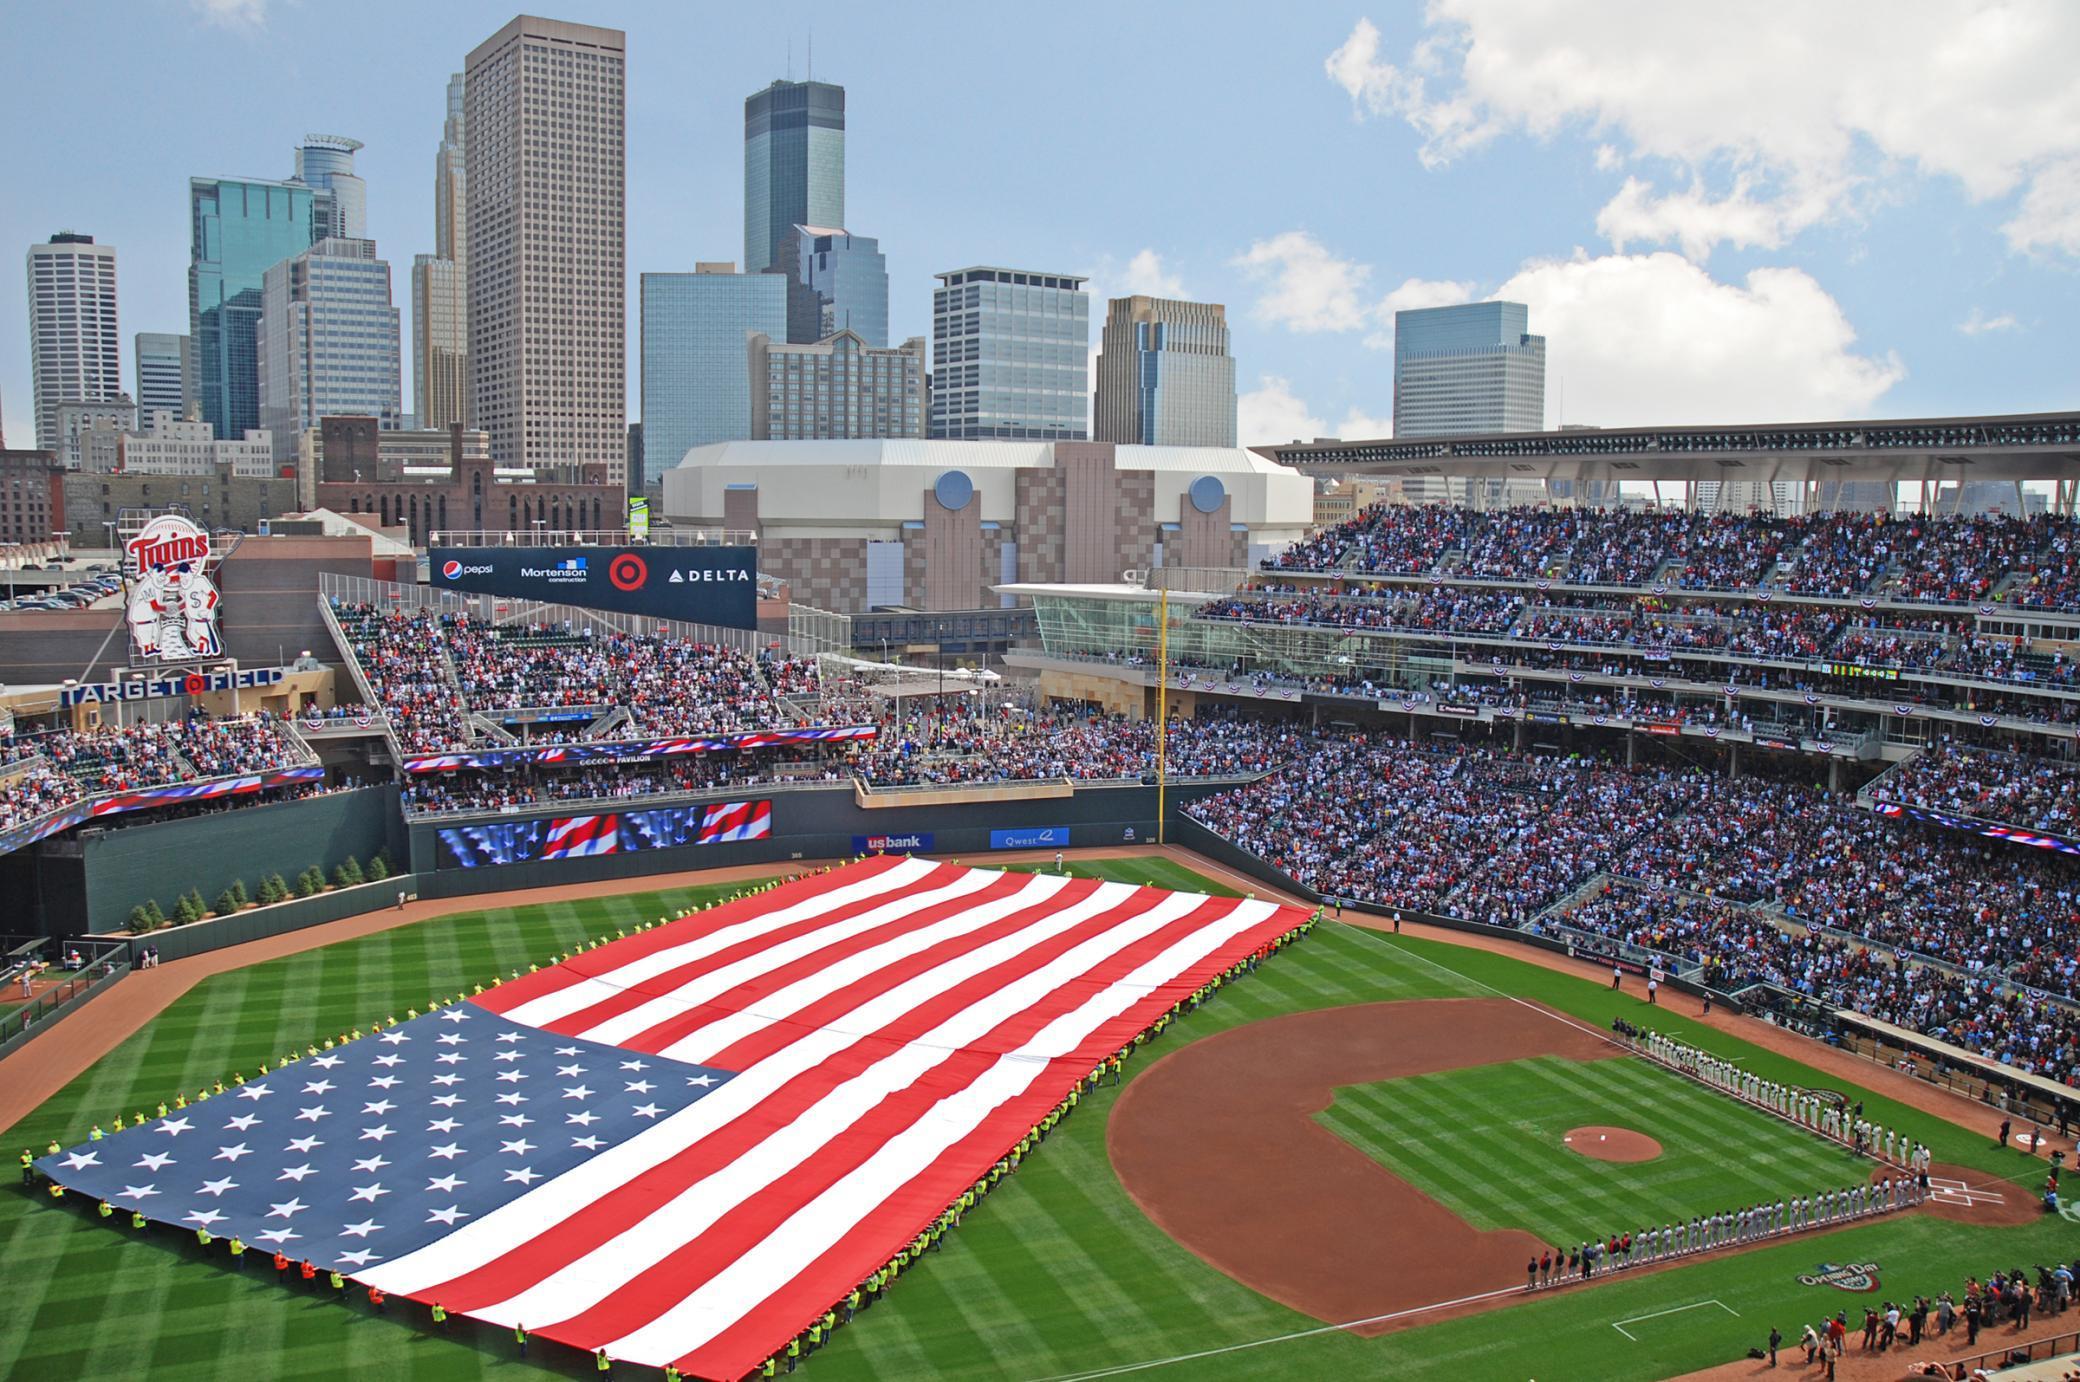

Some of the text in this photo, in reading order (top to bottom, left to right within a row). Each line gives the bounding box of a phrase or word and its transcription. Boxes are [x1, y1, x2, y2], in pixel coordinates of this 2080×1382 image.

[129, 532, 209, 575] Twins
[464, 564, 493, 575] pepsi
[521, 568, 587, 577] Mortenson
[689, 569, 749, 582] DELTA
[190, 591, 202, 609] S
[64, 670, 285, 707] TARGET FIELD
[617, 755, 651, 764] PAVILION
[1005, 837, 1038, 847] Qwest
